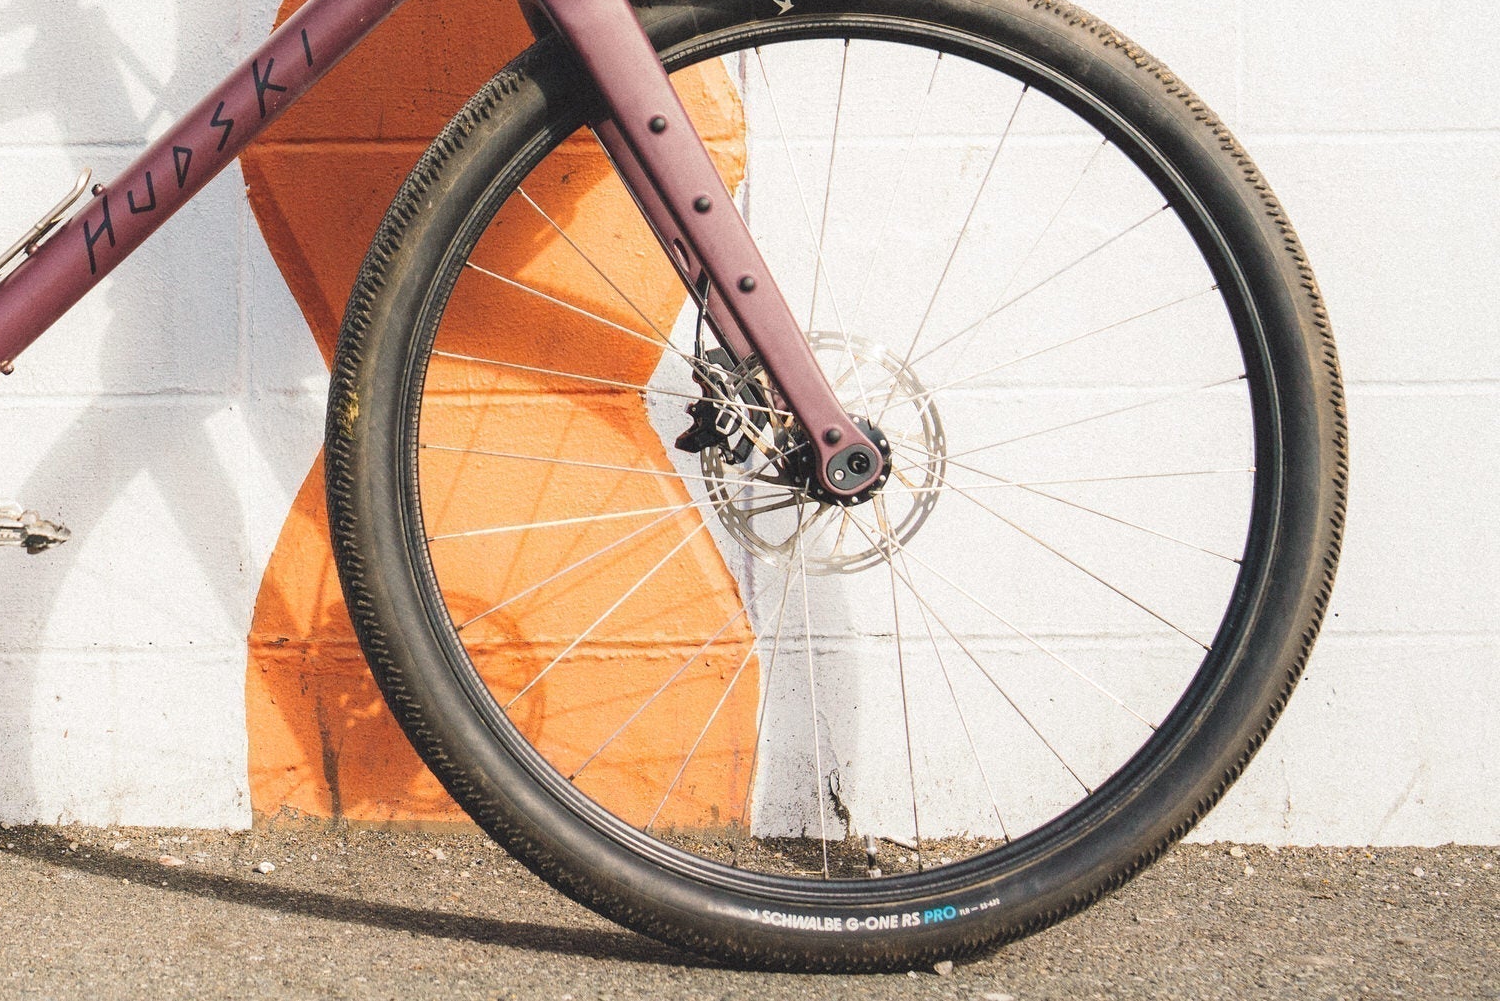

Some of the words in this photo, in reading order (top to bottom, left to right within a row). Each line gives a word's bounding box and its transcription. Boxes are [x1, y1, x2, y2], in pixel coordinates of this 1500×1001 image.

[83, 28, 313, 275] HUDSKI
[761, 910, 842, 931] SCHWALBE
[845, 916, 899, 931] G-ONE
[901, 912, 921, 927] RS
[924, 905, 957, 924] PRO
